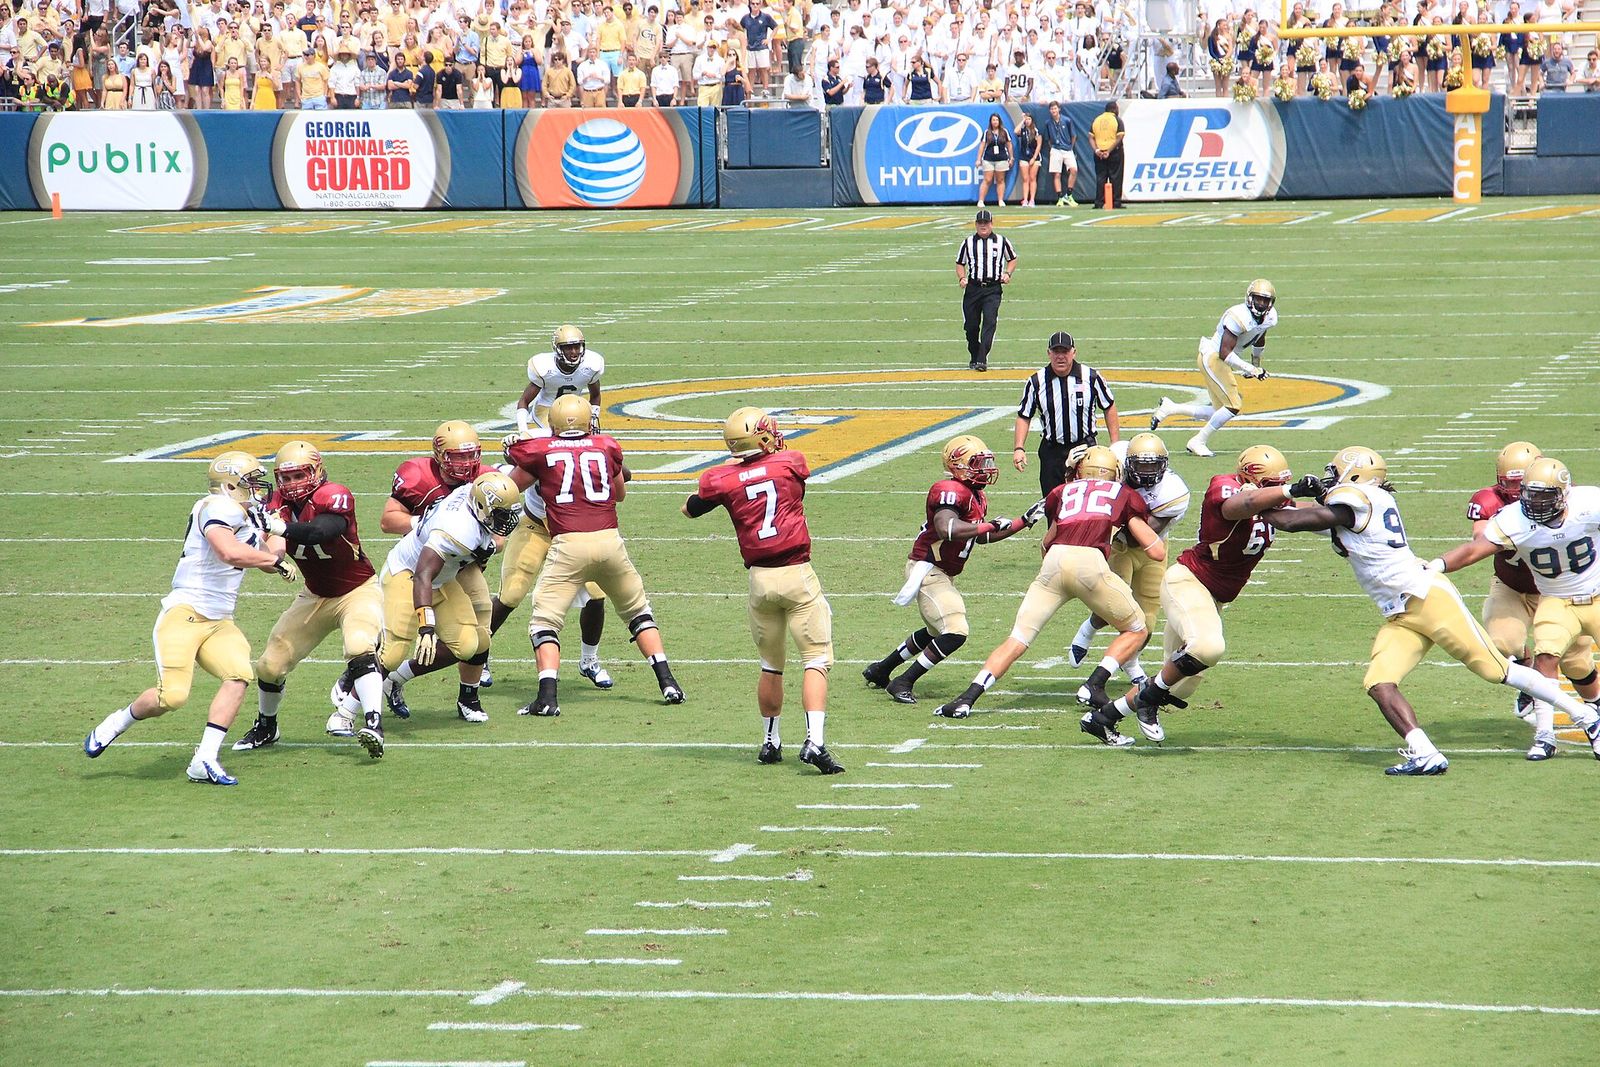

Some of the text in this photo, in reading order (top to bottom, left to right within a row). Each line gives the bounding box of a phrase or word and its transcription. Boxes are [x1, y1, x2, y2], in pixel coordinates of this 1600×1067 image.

[1010, 74, 1027, 88] 20
[305, 121, 372, 138] GEORGIA
[305, 139, 387, 156] NATIONAL
[1454, 114, 1476, 199] ACC
[48, 142, 182, 174] Publix
[306, 157, 411, 192] GUARD
[879, 166, 997, 186] HYUNDA
[1132, 161, 1257, 179] RUSSELL
[1129, 180, 1256, 193] ATHLETIC
[323, 200, 396, 208] 1-800-GO-GUARD
[547, 439, 594, 449] JOHNSON
[545, 452, 610, 504] 70
[331, 494, 348, 510] 71
[940, 491, 957, 505] 10
[1058, 479, 1122, 520] 82
[745, 479, 778, 540] 7
[1530, 536, 1597, 579] 98
